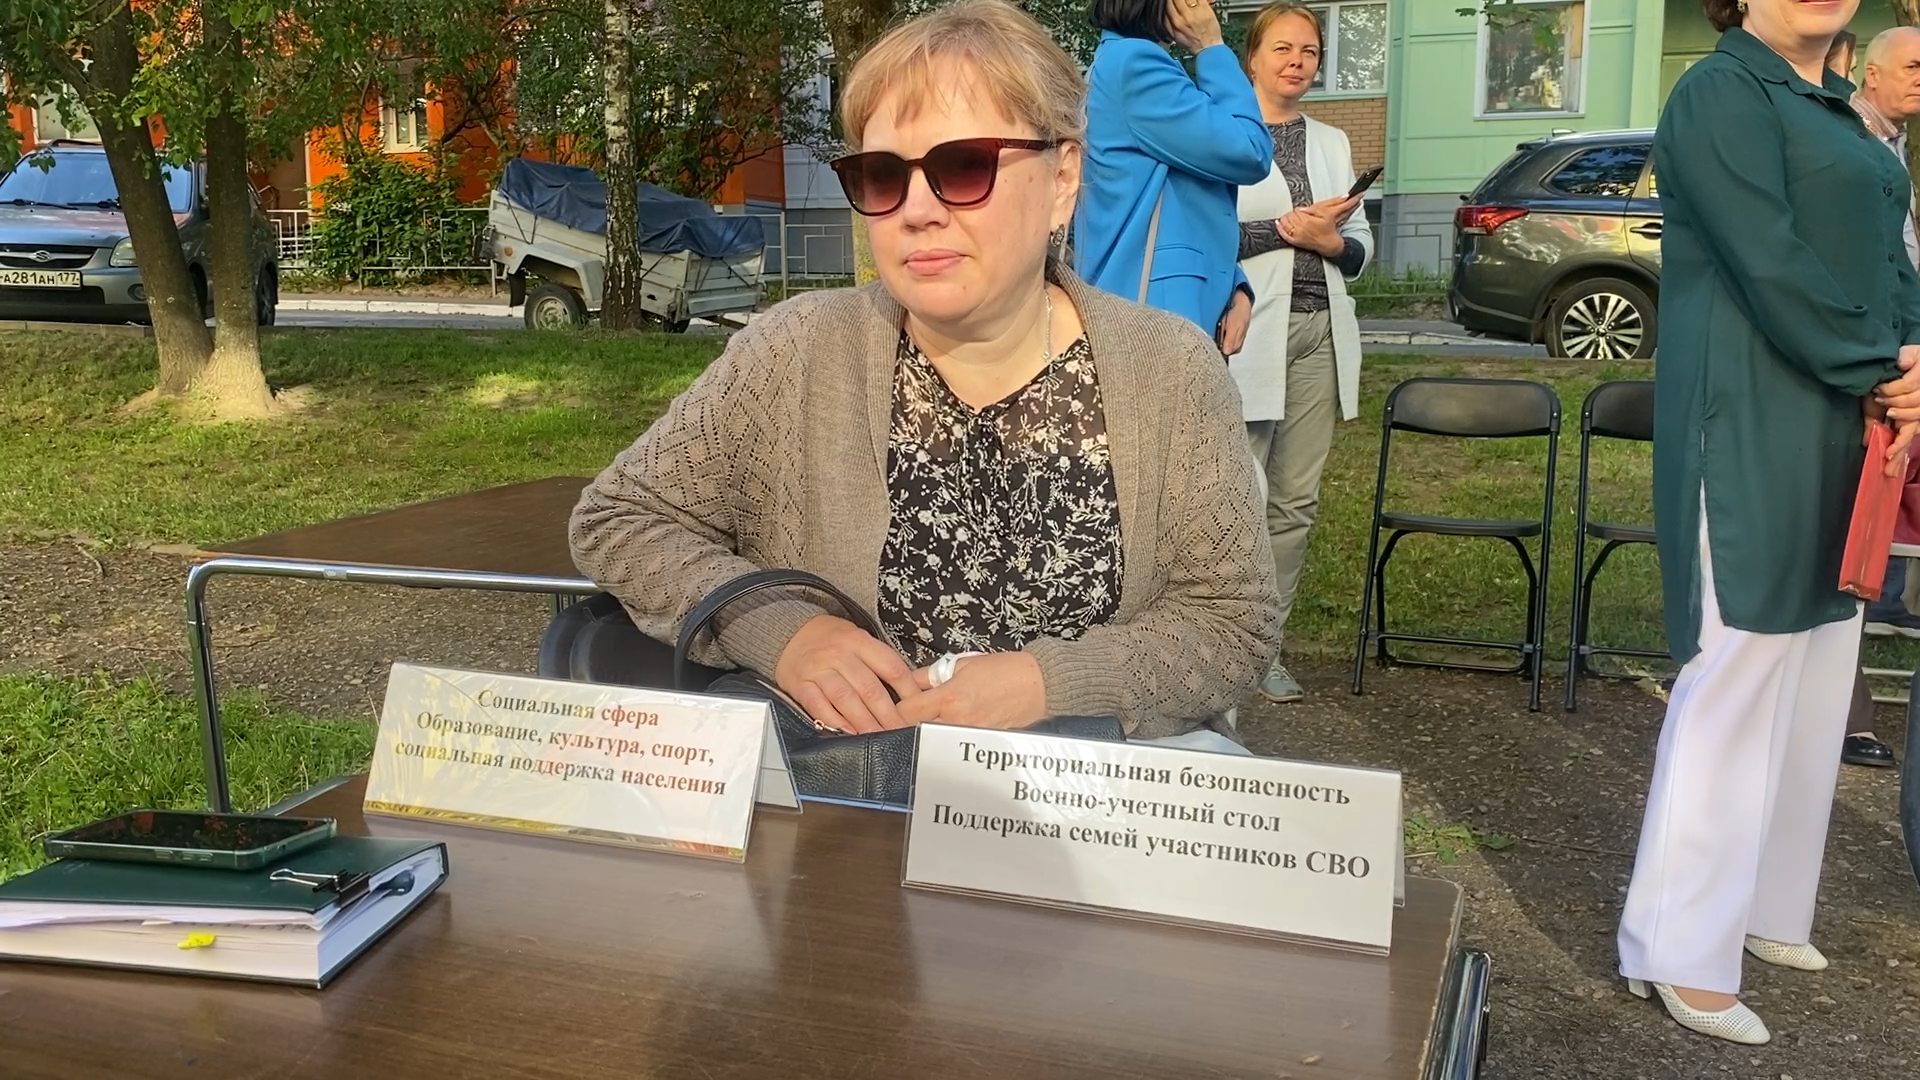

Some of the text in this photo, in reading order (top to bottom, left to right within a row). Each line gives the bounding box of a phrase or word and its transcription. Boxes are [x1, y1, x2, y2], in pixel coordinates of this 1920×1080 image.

[478, 689, 659, 729] Социальная сфера
[417, 712, 714, 766] Образование, культура, спорт,
[395, 742, 727, 796] социальная поддержка населения
[959, 741, 1350, 805] Территориальная безопасность
[1013, 780, 1280, 832] Военно-учетный стол
[932, 804, 1370, 878] Поддержка семей участников СВО
